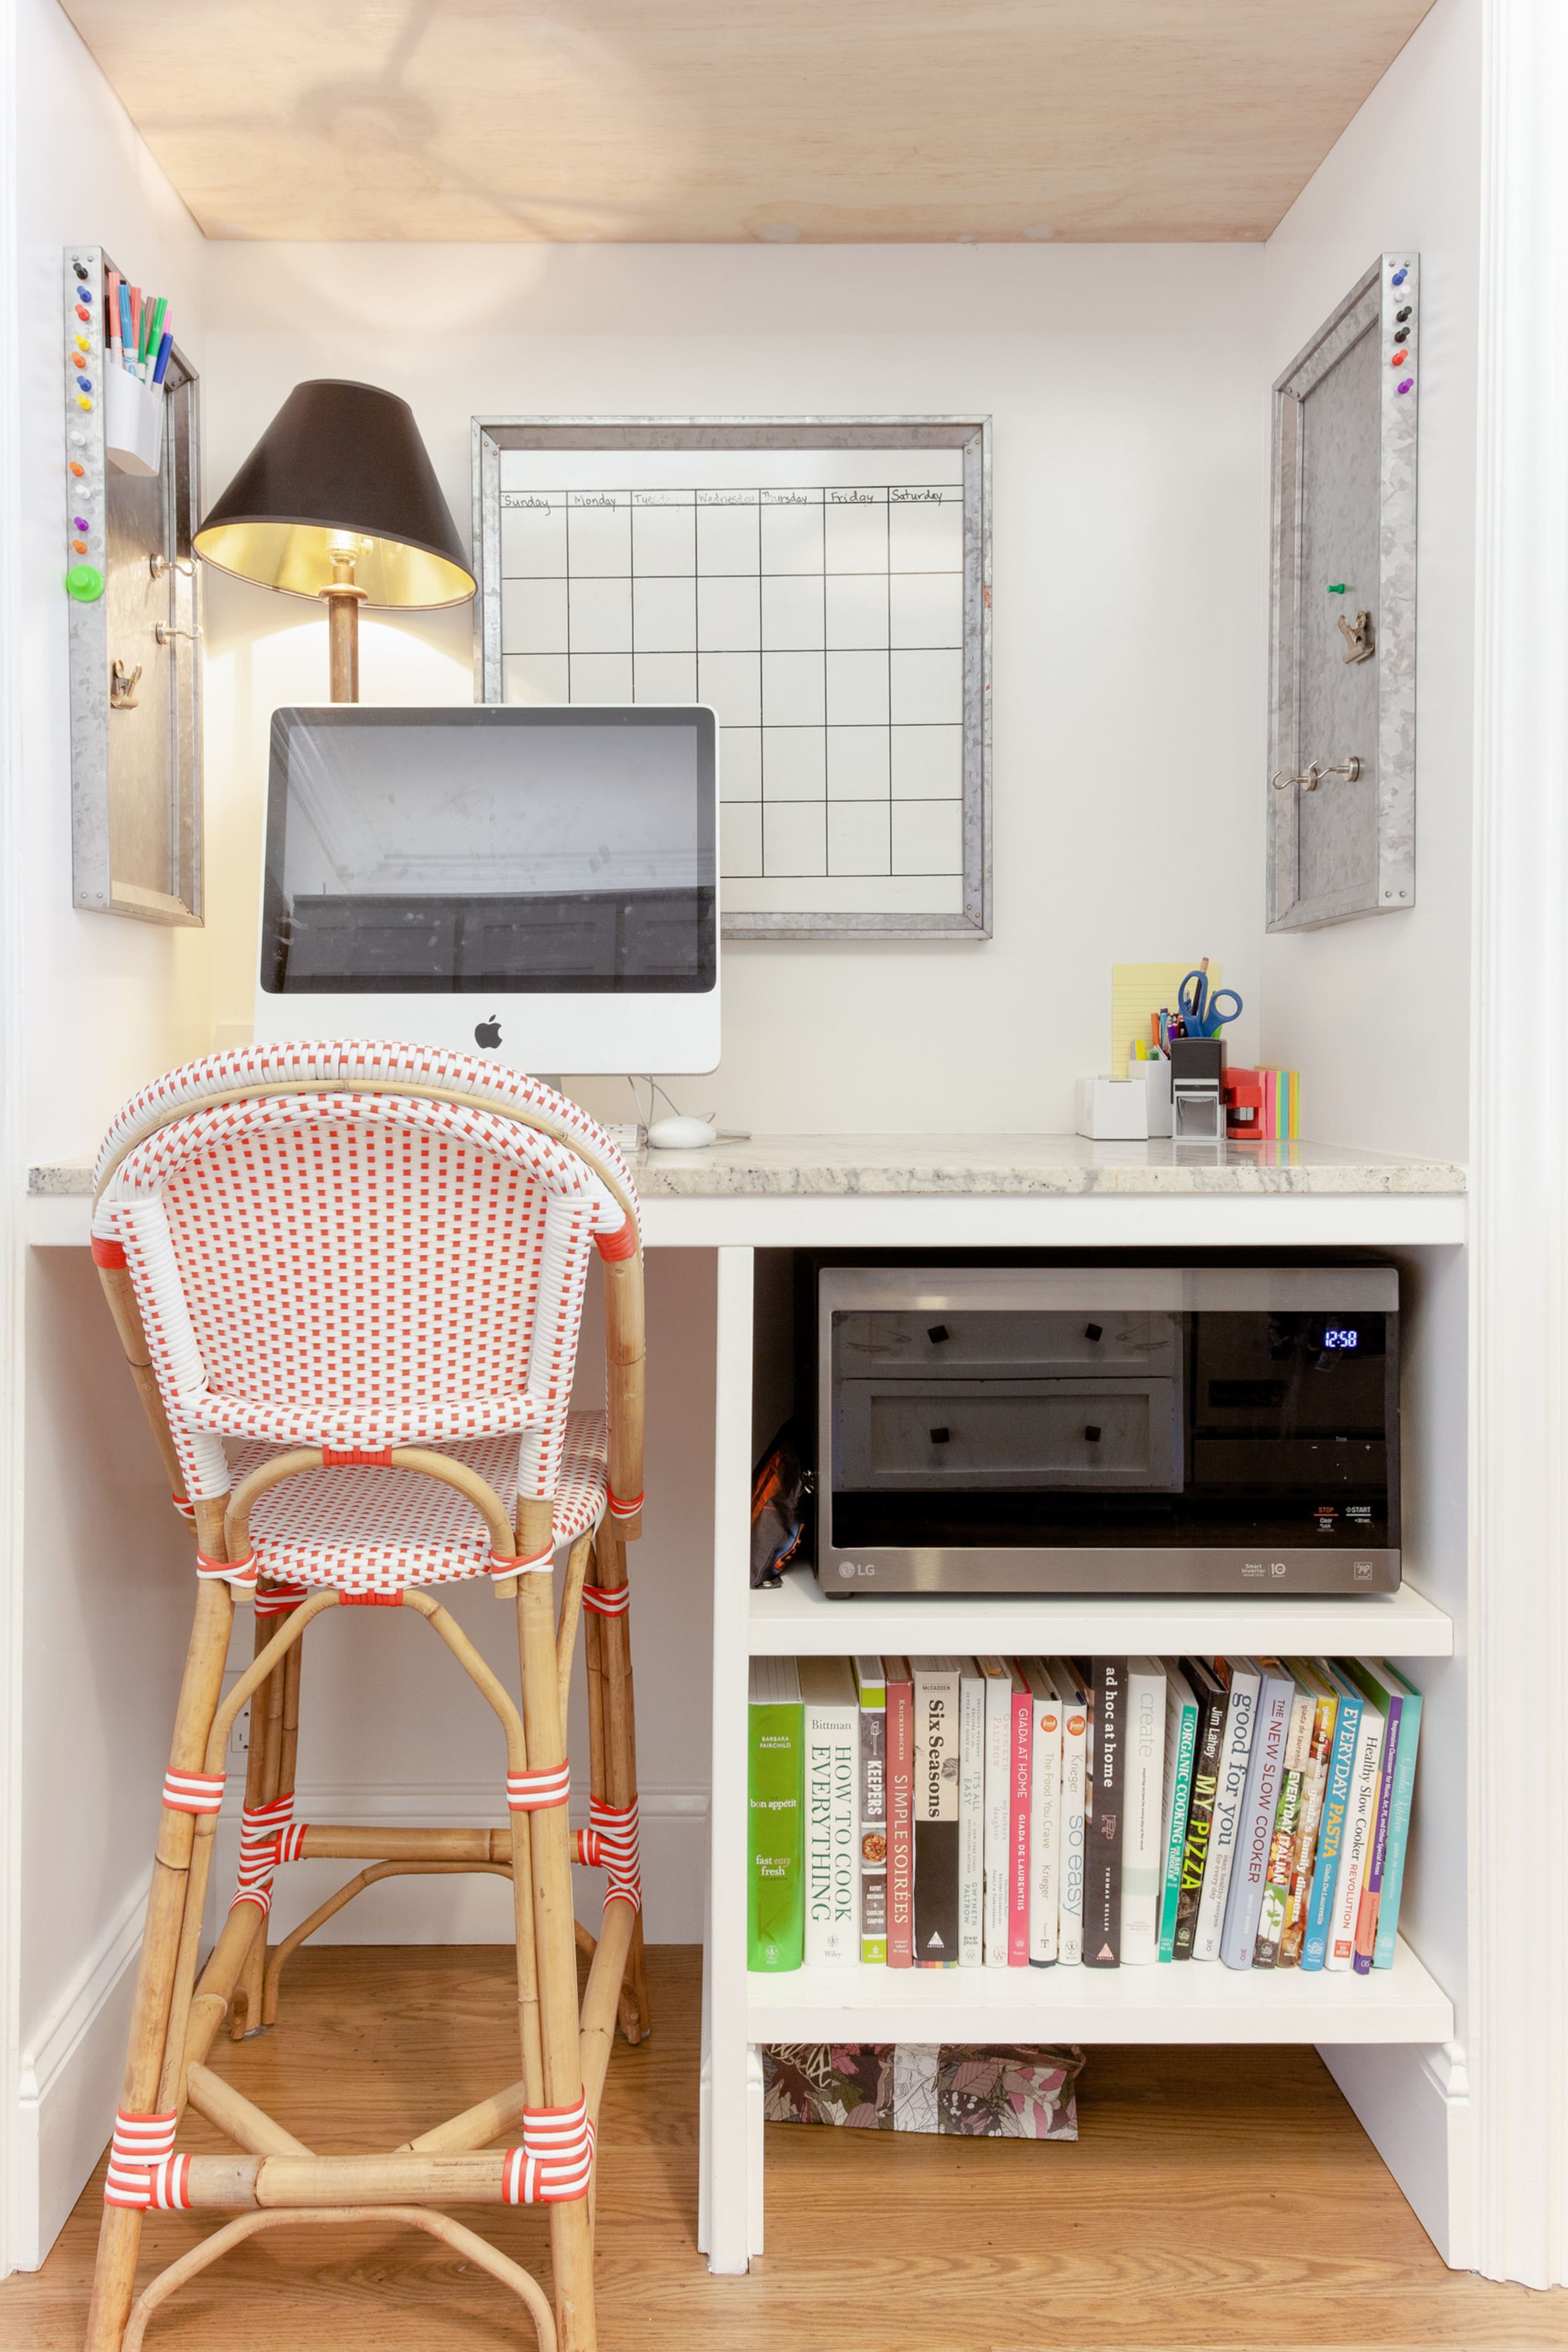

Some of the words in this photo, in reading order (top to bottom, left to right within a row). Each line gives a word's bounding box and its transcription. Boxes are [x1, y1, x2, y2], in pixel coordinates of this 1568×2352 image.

[504, 494, 551, 515] Sunday
[575, 495, 616, 512] Monday
[762, 491, 807, 504] Thursday
[831, 492, 873, 504] Friday
[891, 489, 942, 506] Saturday
[1325, 1331, 1357, 1347] 12:58
[858, 1564, 875, 1576] LG
[1271, 1563, 1286, 1575] 10
[1106, 1667, 1118, 1686] ad
[929, 1700, 945, 1732] Six
[1105, 1691, 1118, 1719] hoc
[1210, 1706, 1223, 1726] Jim
[1275, 1699, 1286, 1719] THE
[1300, 1704, 1310, 1725] giada
[1320, 1706, 1330, 1730] giada
[812, 1719, 851, 1730] Bittman
[1017, 1708, 1028, 1744] GIADA
[1104, 1723, 1115, 1739] at
[1139, 1693, 1155, 1757] create
[1231, 1692, 1252, 1755] good
[1318, 1731, 1328, 1742] de
[1390, 1719, 1400, 1747] Responsive
[1018, 1747, 1028, 1760] AT
[1177, 1722, 1194, 1782] ORGANIC
[1204, 1729, 1220, 1758] Lahey
[1266, 1720, 1283, 1760] NEW
[1293, 1736, 1305, 1769] laurentiis
[1332, 1706, 1359, 1801] EVERYDAY
[835, 1745, 852, 1803] HOW
[1044, 1753, 1054, 1770] The
[1068, 1754, 1084, 1794] Krieger
[1104, 1743, 1117, 1788] home
[1359, 1736, 1378, 1783] Healthy
[867, 1760, 883, 1815] KEEPERS
[929, 1736, 944, 1818] Seasons
[963, 1779, 972, 1805] EASY
[1017, 1763, 1028, 1799] HOME
[1043, 1774, 1054, 1797] Food
[1226, 1762, 1246, 1798] for
[1258, 1763, 1276, 1811] SLOW
[1383, 1783, 1392, 1799] Music,
[750, 1799, 767, 1808] bon
[894, 1775, 908, 1840] SIMPLE
[1193, 1774, 1216, 1812] MY
[1281, 1771, 1300, 1834] EVERYDAY
[1357, 1785, 1372, 1815] Slow
[1042, 1800, 1053, 1818] You
[1172, 1783, 1188, 1844] COOKING
[1218, 1802, 1237, 1846] you
[1304, 1788, 1317, 1833] giada's
[1393, 1796, 1409, 1834] Kitchen
[811, 1744, 831, 1922] EVERYTHING
[835, 1810, 852, 1845] TO
[1017, 1813, 1026, 1842] GIADA
[1042, 1821, 1052, 1849] Crave
[1068, 1815, 1084, 1847] so
[1322, 1802, 1344, 1859] PASTA
[1351, 1818, 1367, 1862] Cooker
[756, 1855, 773, 1865] fast
[774, 1857, 791, 1868] easy
[1017, 1845, 1025, 1856] DE
[1181, 1820, 1209, 1889] PIZZA
[1248, 1815, 1268, 1883] COOKER
[1272, 1834, 1291, 1885] ITALIAN
[1296, 1836, 1313, 1874] family
[1375, 1843, 1385, 1861] Special
[761, 1866, 785, 1876] fresh
[1039, 1864, 1052, 1899] Krieger
[1211, 1865, 1219, 1886] every
[1324, 1863, 1332, 1881] Giada
[1374, 1861, 1382, 1875] Areas
[834, 1853, 852, 1922] COOK
[894, 1845, 911, 1924] SOIRÉES
[1063, 1855, 1082, 1916] easy
[1208, 1886, 1217, 1900] day
[1216, 1872, 1227, 1900] healthy
[1291, 1876, 1306, 1923] dinners
[1322, 1882, 1329, 1891] De
[1342, 1863, 1359, 1929] REVOLUTION
[1213, 1901, 1222, 1928] recipes
[1317, 1892, 1328, 1925] Laurentiis
